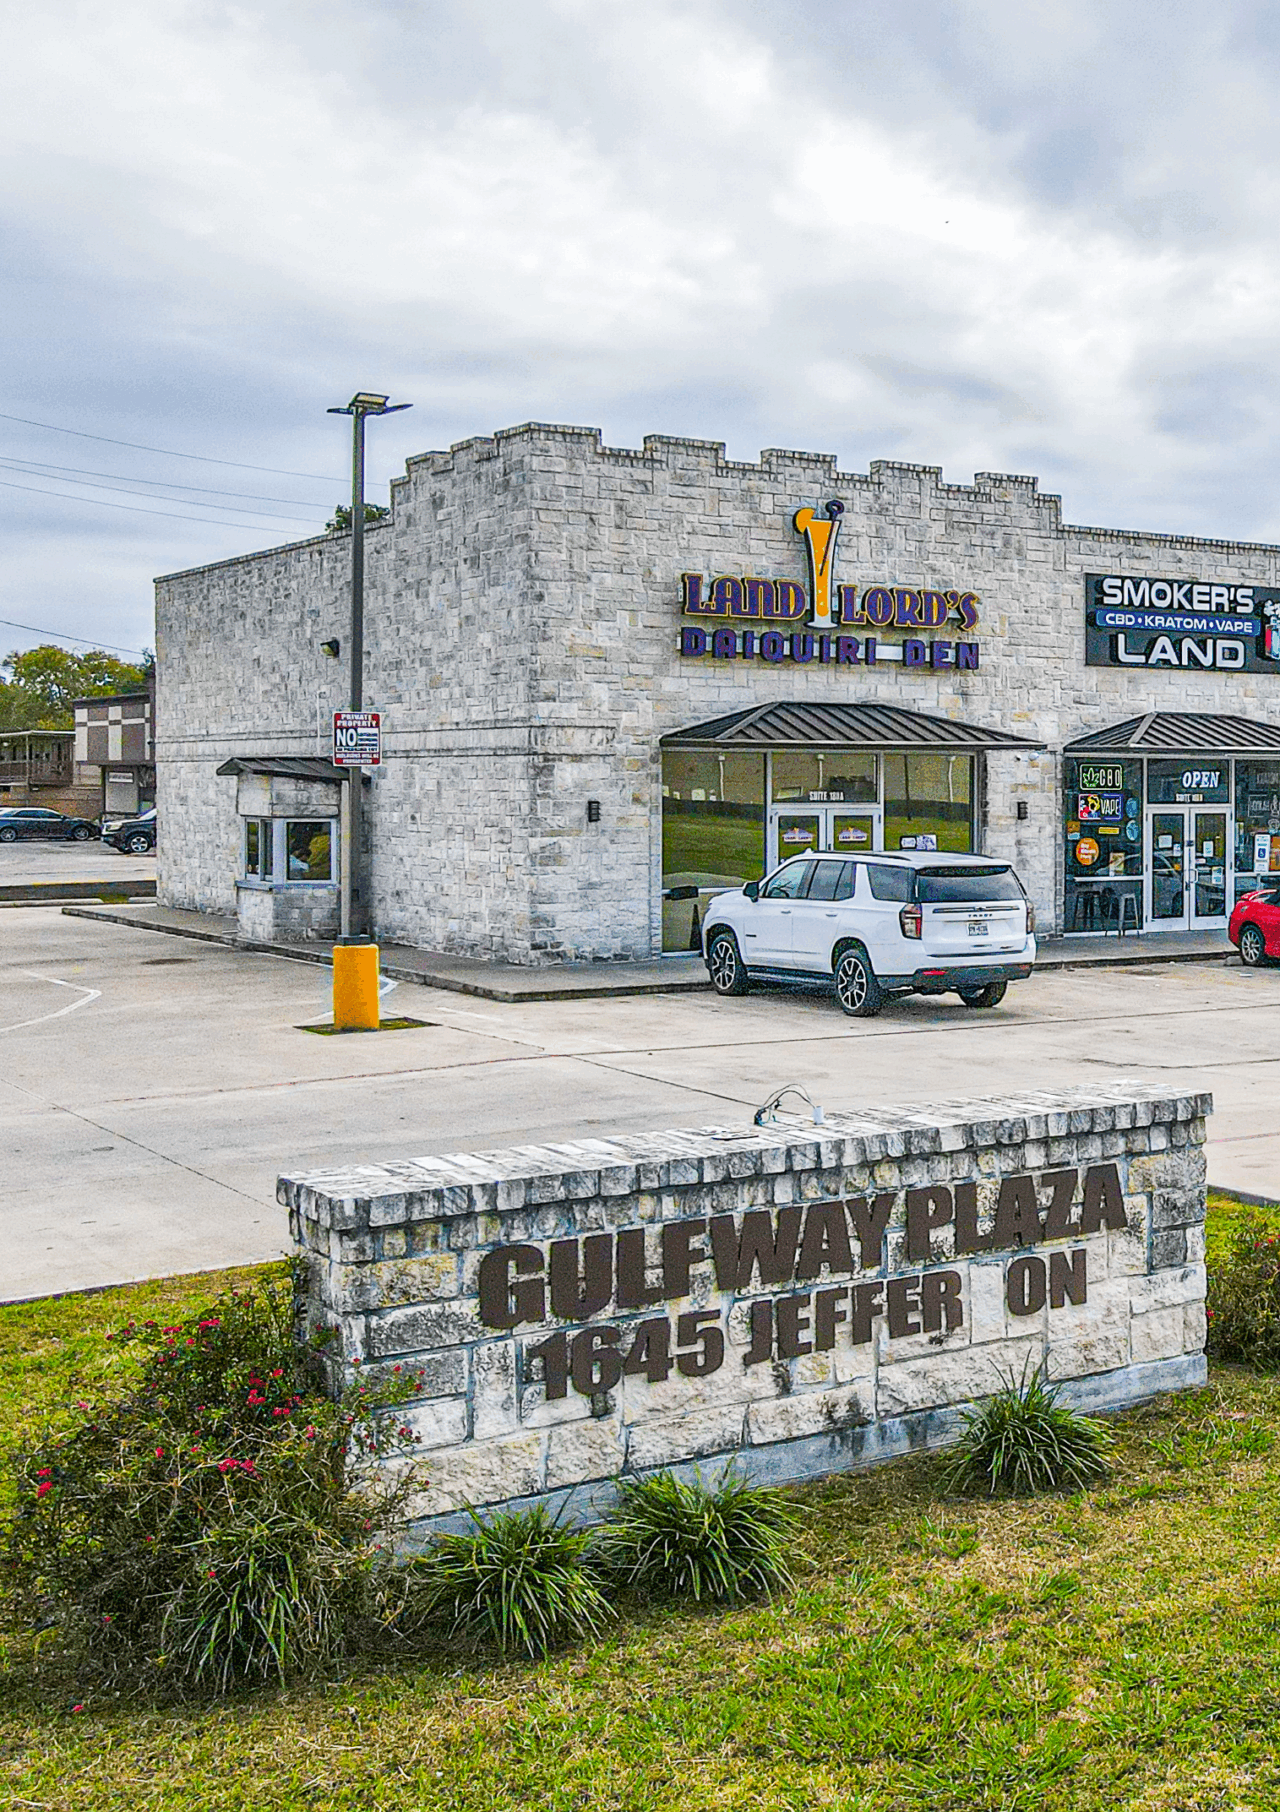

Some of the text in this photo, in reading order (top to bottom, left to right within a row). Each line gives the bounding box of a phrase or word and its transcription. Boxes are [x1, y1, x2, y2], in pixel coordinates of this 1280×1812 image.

[680, 572, 981, 632] LAND LORD'S
[1102, 577, 1254, 613] SMOKER'S
[1105, 613, 1253, 633] CBD KRATOM VAPE
[681, 626, 980, 670] DAIQUIRI DEN
[1118, 632, 1246, 668] LAND
[336, 728, 357, 746] NO
[1182, 771, 1220, 788] OPEN
[1100, 799, 1120, 815] VAPE
[478, 1162, 1127, 1330] GULFWAY PLAZA
[531, 1309, 725, 1400] 1645
